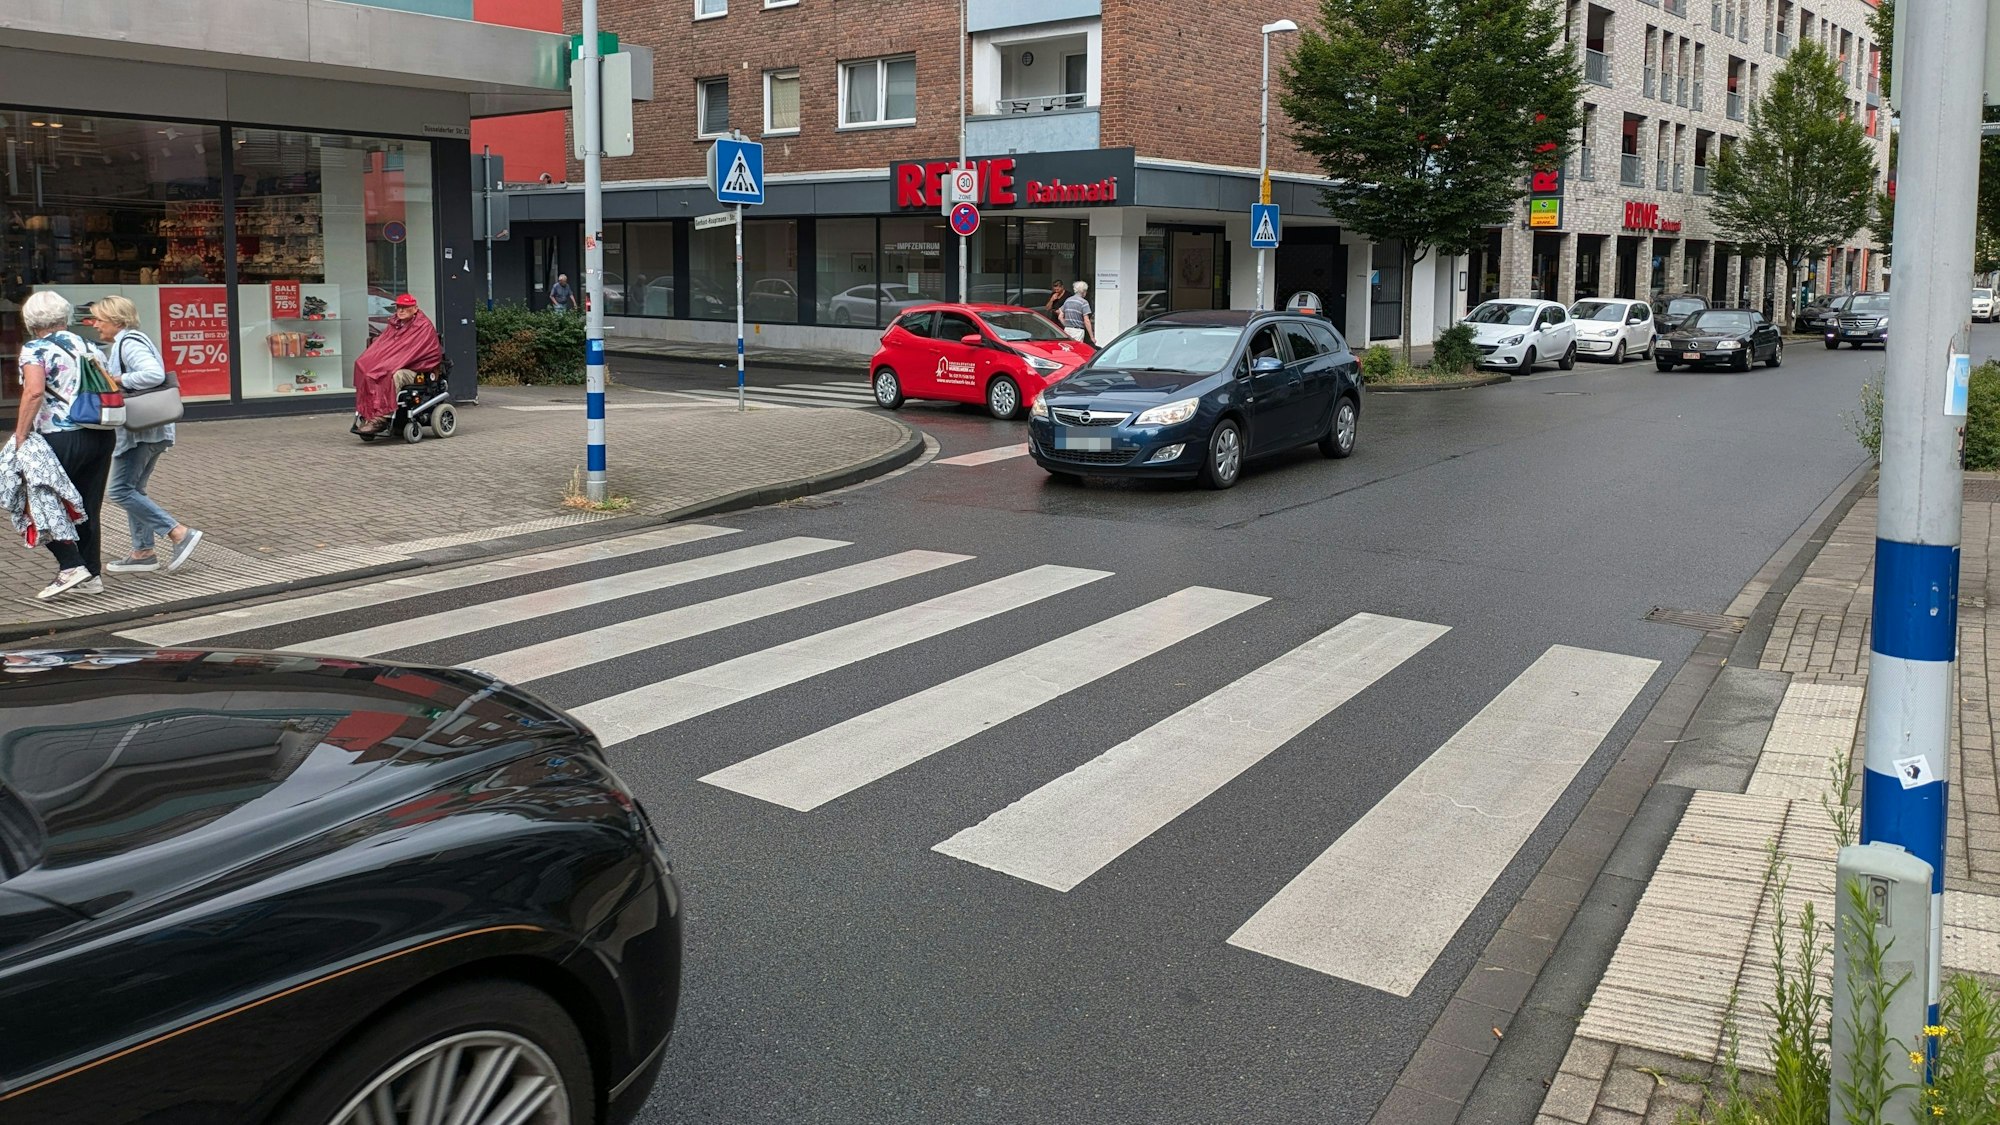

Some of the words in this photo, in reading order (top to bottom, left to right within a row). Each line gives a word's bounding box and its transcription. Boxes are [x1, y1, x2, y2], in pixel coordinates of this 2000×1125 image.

[960, 177, 971, 188] 30
[1026, 176, 1118, 203] Rahmati
[1624, 200, 1659, 230] REWE
[897, 242, 940, 250] IMPFZENTRUM
[1037, 242, 1076, 250] IMPFZENTRUM
[275, 300, 297, 309] 75%
[168, 303, 227, 319] SALE
[169, 319, 228, 328] FINALE
[172, 332, 202, 340] JETZT
[171, 343, 228, 365] 75%
